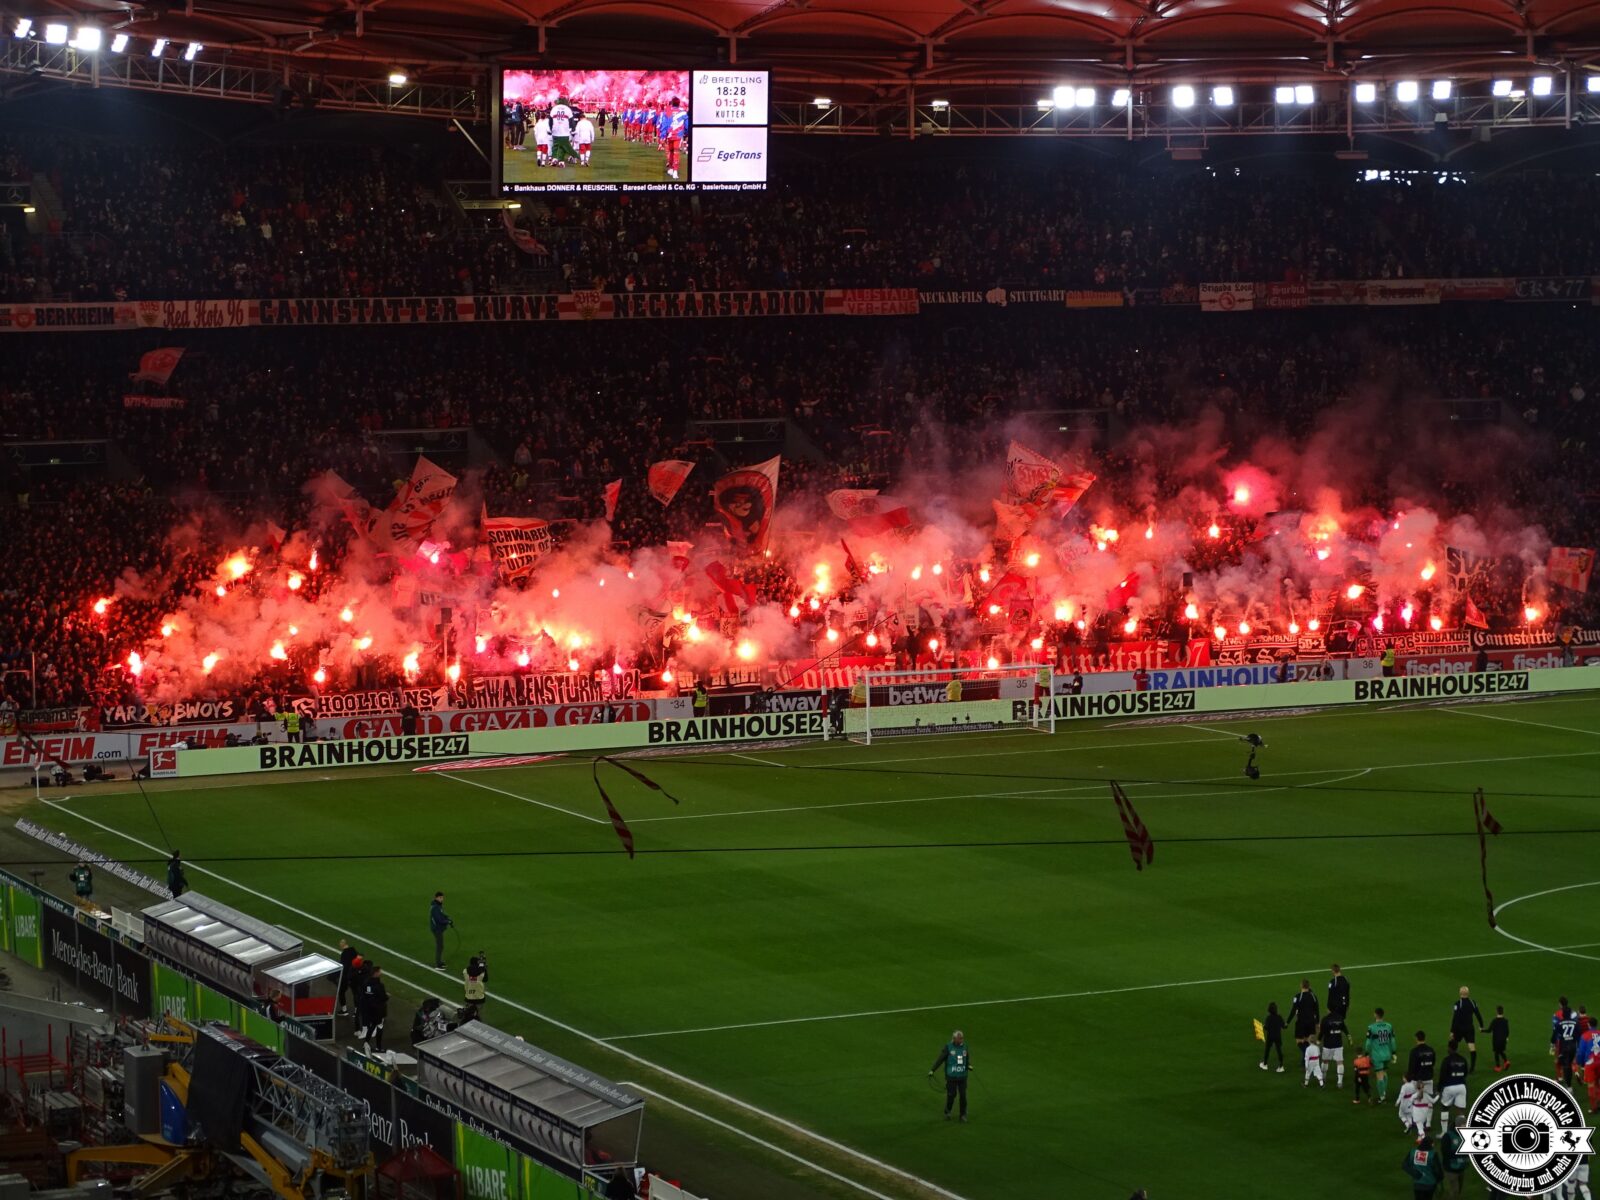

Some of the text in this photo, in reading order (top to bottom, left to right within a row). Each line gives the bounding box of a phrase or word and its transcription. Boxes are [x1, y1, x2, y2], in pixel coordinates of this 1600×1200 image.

[716, 86, 746, 96] 18:28
[715, 98, 746, 107] 01:54
[715, 110, 745, 118] KUTTER
[717, 150, 762, 162] EgeTrans
[647, 184, 667, 192] GmbH
[845, 288, 917, 300] ALBSTADT
[1009, 289, 1066, 303] STUTTGART
[259, 294, 559, 325] CANNSTATTER KURVE
[613, 291, 825, 318] NECKARSTADION
[35, 307, 115, 326] BERKHEIM
[163, 301, 191, 329] Red
[227, 299, 243, 325] 96
[1397, 635, 1415, 649] 36
[1415, 645, 1470, 655] STUTTGART
[1362, 660, 1374, 669] 36
[1405, 657, 1473, 676] fischer
[1513, 653, 1579, 671] fischr
[1016, 680, 1028, 689] 35
[318, 689, 432, 712] HOOLIGANS
[889, 687, 956, 705] betwa
[174, 700, 234, 720] BWOYS
[353, 715, 436, 739] GAI
[460, 709, 541, 731] GAZI
[51, 928, 114, 989] Mercedes-Benz
[116, 963, 139, 1004] Bank
[1561, 1024, 1576, 1038] 27
